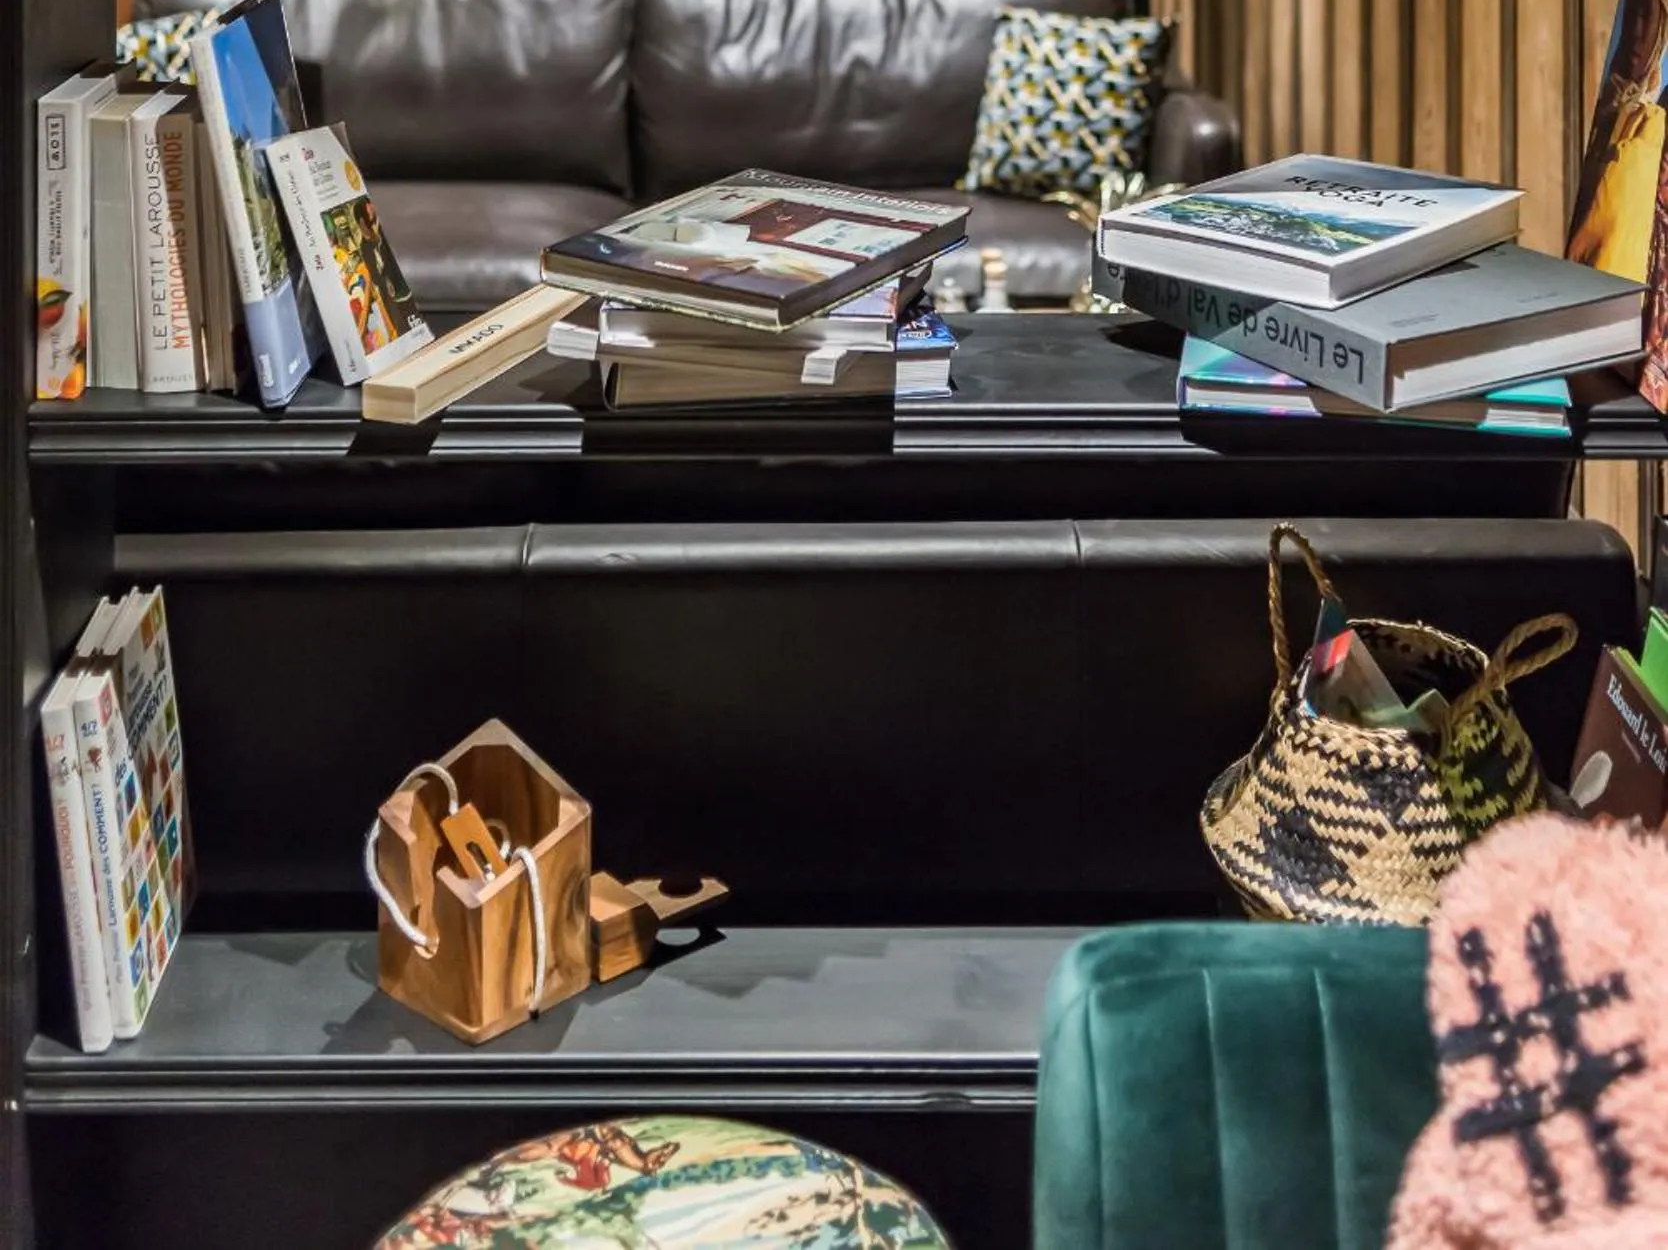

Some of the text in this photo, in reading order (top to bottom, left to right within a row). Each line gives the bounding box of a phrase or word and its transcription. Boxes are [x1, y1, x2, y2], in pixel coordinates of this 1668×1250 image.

[50, 122, 60, 162] SLOW
[852, 192, 951, 215] Interiors
[1285, 175, 1438, 208] RETRAITE
[1306, 186, 1384, 207] YOGA
[144, 133, 168, 350] LE PETIT LAROUSSE
[164, 131, 191, 349] MYTHOLOGIES DU MONDE
[1187, 292, 1222, 327] Val
[1228, 307, 1257, 338] de
[1265, 317, 1324, 368] Livre
[1333, 342, 1364, 384] Le
